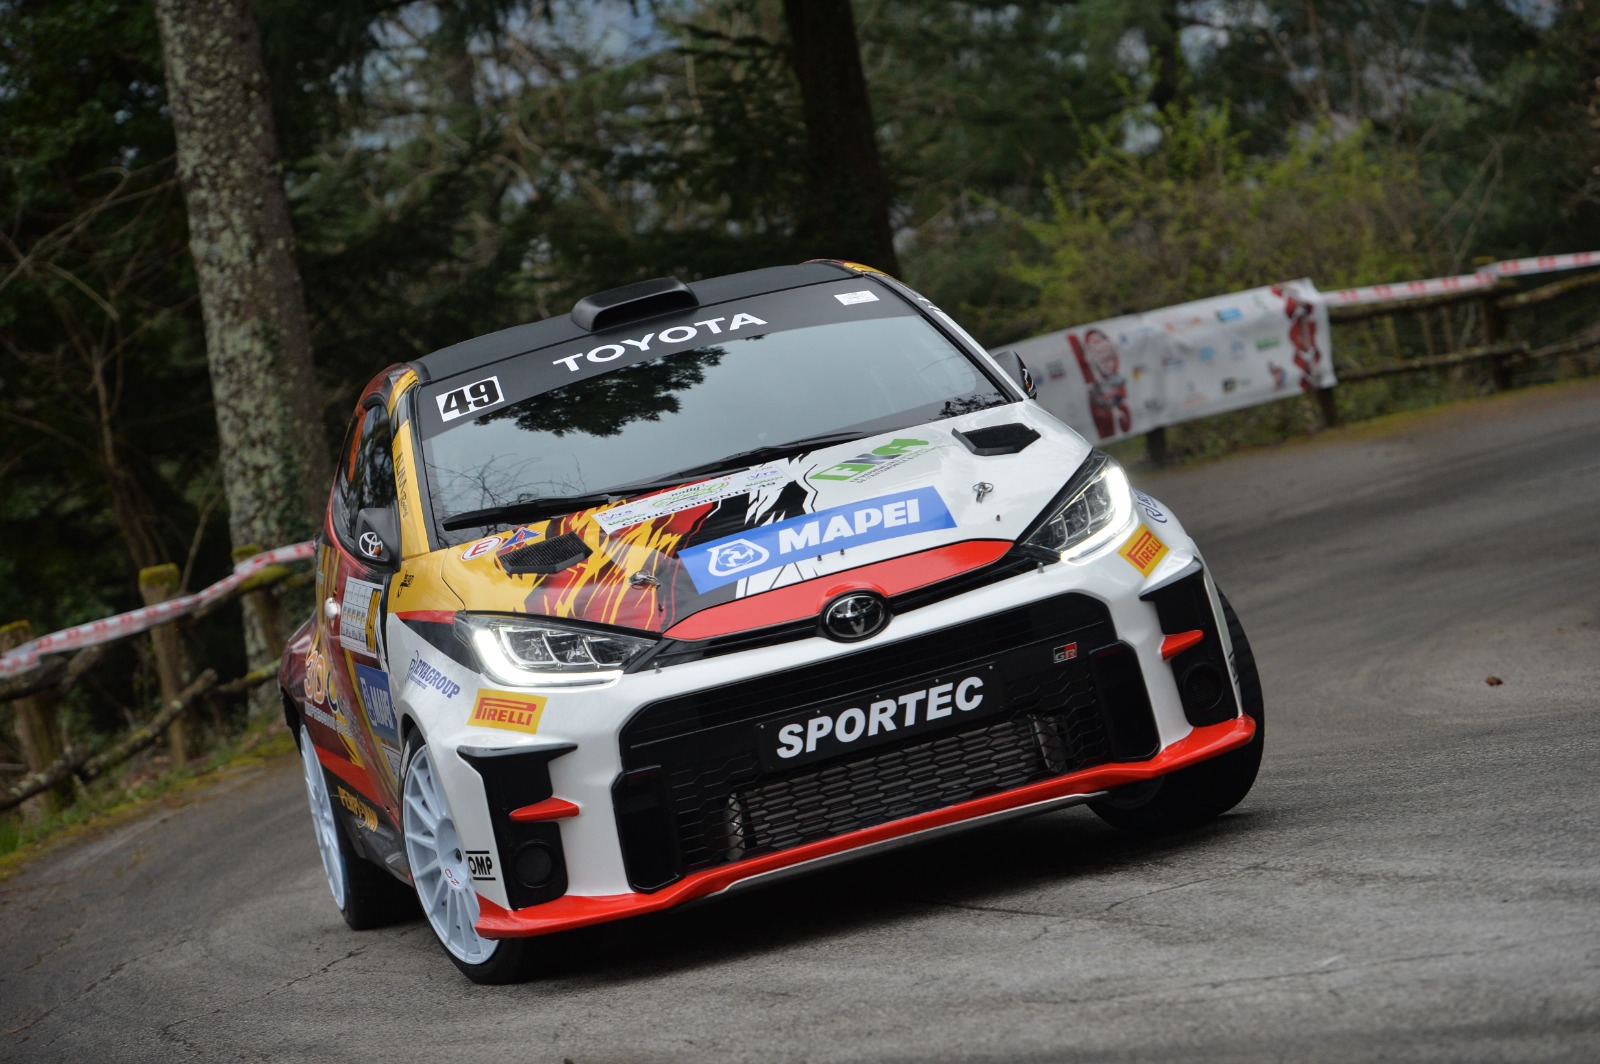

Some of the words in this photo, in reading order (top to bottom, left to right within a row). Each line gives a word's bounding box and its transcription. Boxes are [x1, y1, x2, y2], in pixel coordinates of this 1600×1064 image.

[552, 312, 767, 372] TOYOTA
[442, 379, 500, 414] 49
[622, 487, 752, 526] CONCORRENTE
[778, 498, 920, 555] MAPEI
[469, 539, 493, 557] E
[1126, 530, 1163, 570] PIRELLI
[475, 697, 536, 726] PIRELLI
[776, 676, 984, 759] SPORTEC
[468, 856, 493, 876] OMP
